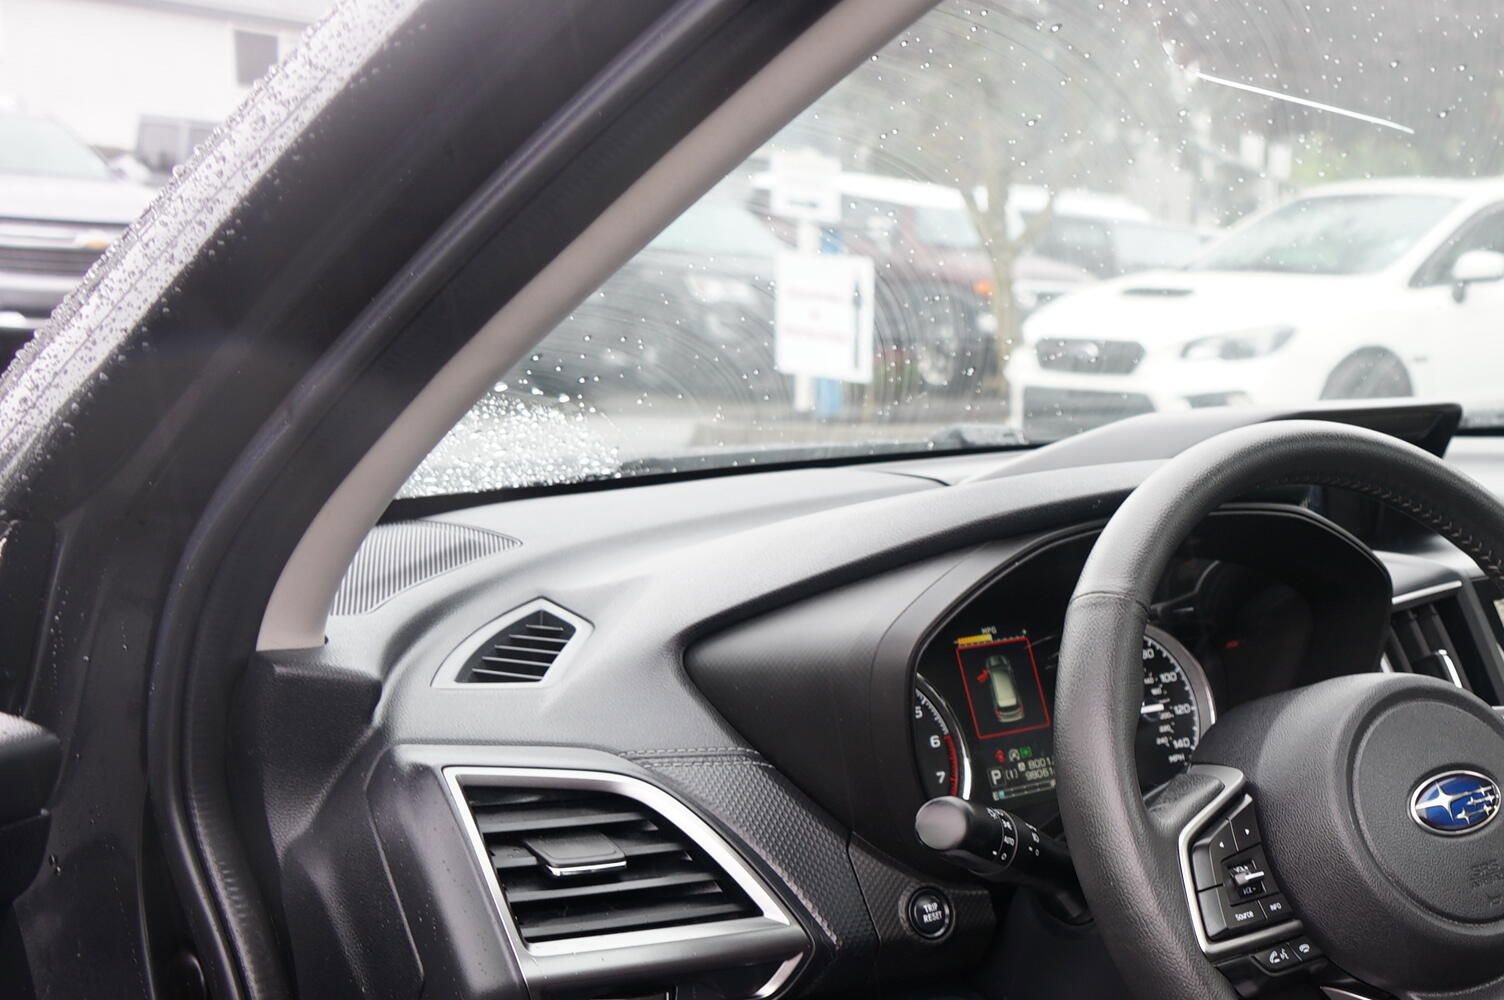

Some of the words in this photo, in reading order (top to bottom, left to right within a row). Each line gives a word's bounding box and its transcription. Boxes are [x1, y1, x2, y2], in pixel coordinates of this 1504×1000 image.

[1159, 672, 1178, 684] 100
[914, 705, 923, 719] 5
[1174, 704, 1191, 716] 120
[929, 734, 941, 748] 6
[1172, 738, 1191, 750] 140
[936, 771, 946, 784] 7
[990, 769, 1002, 785] P
[923, 902, 938, 913] TRIP
[923, 911, 942, 923] RESET
